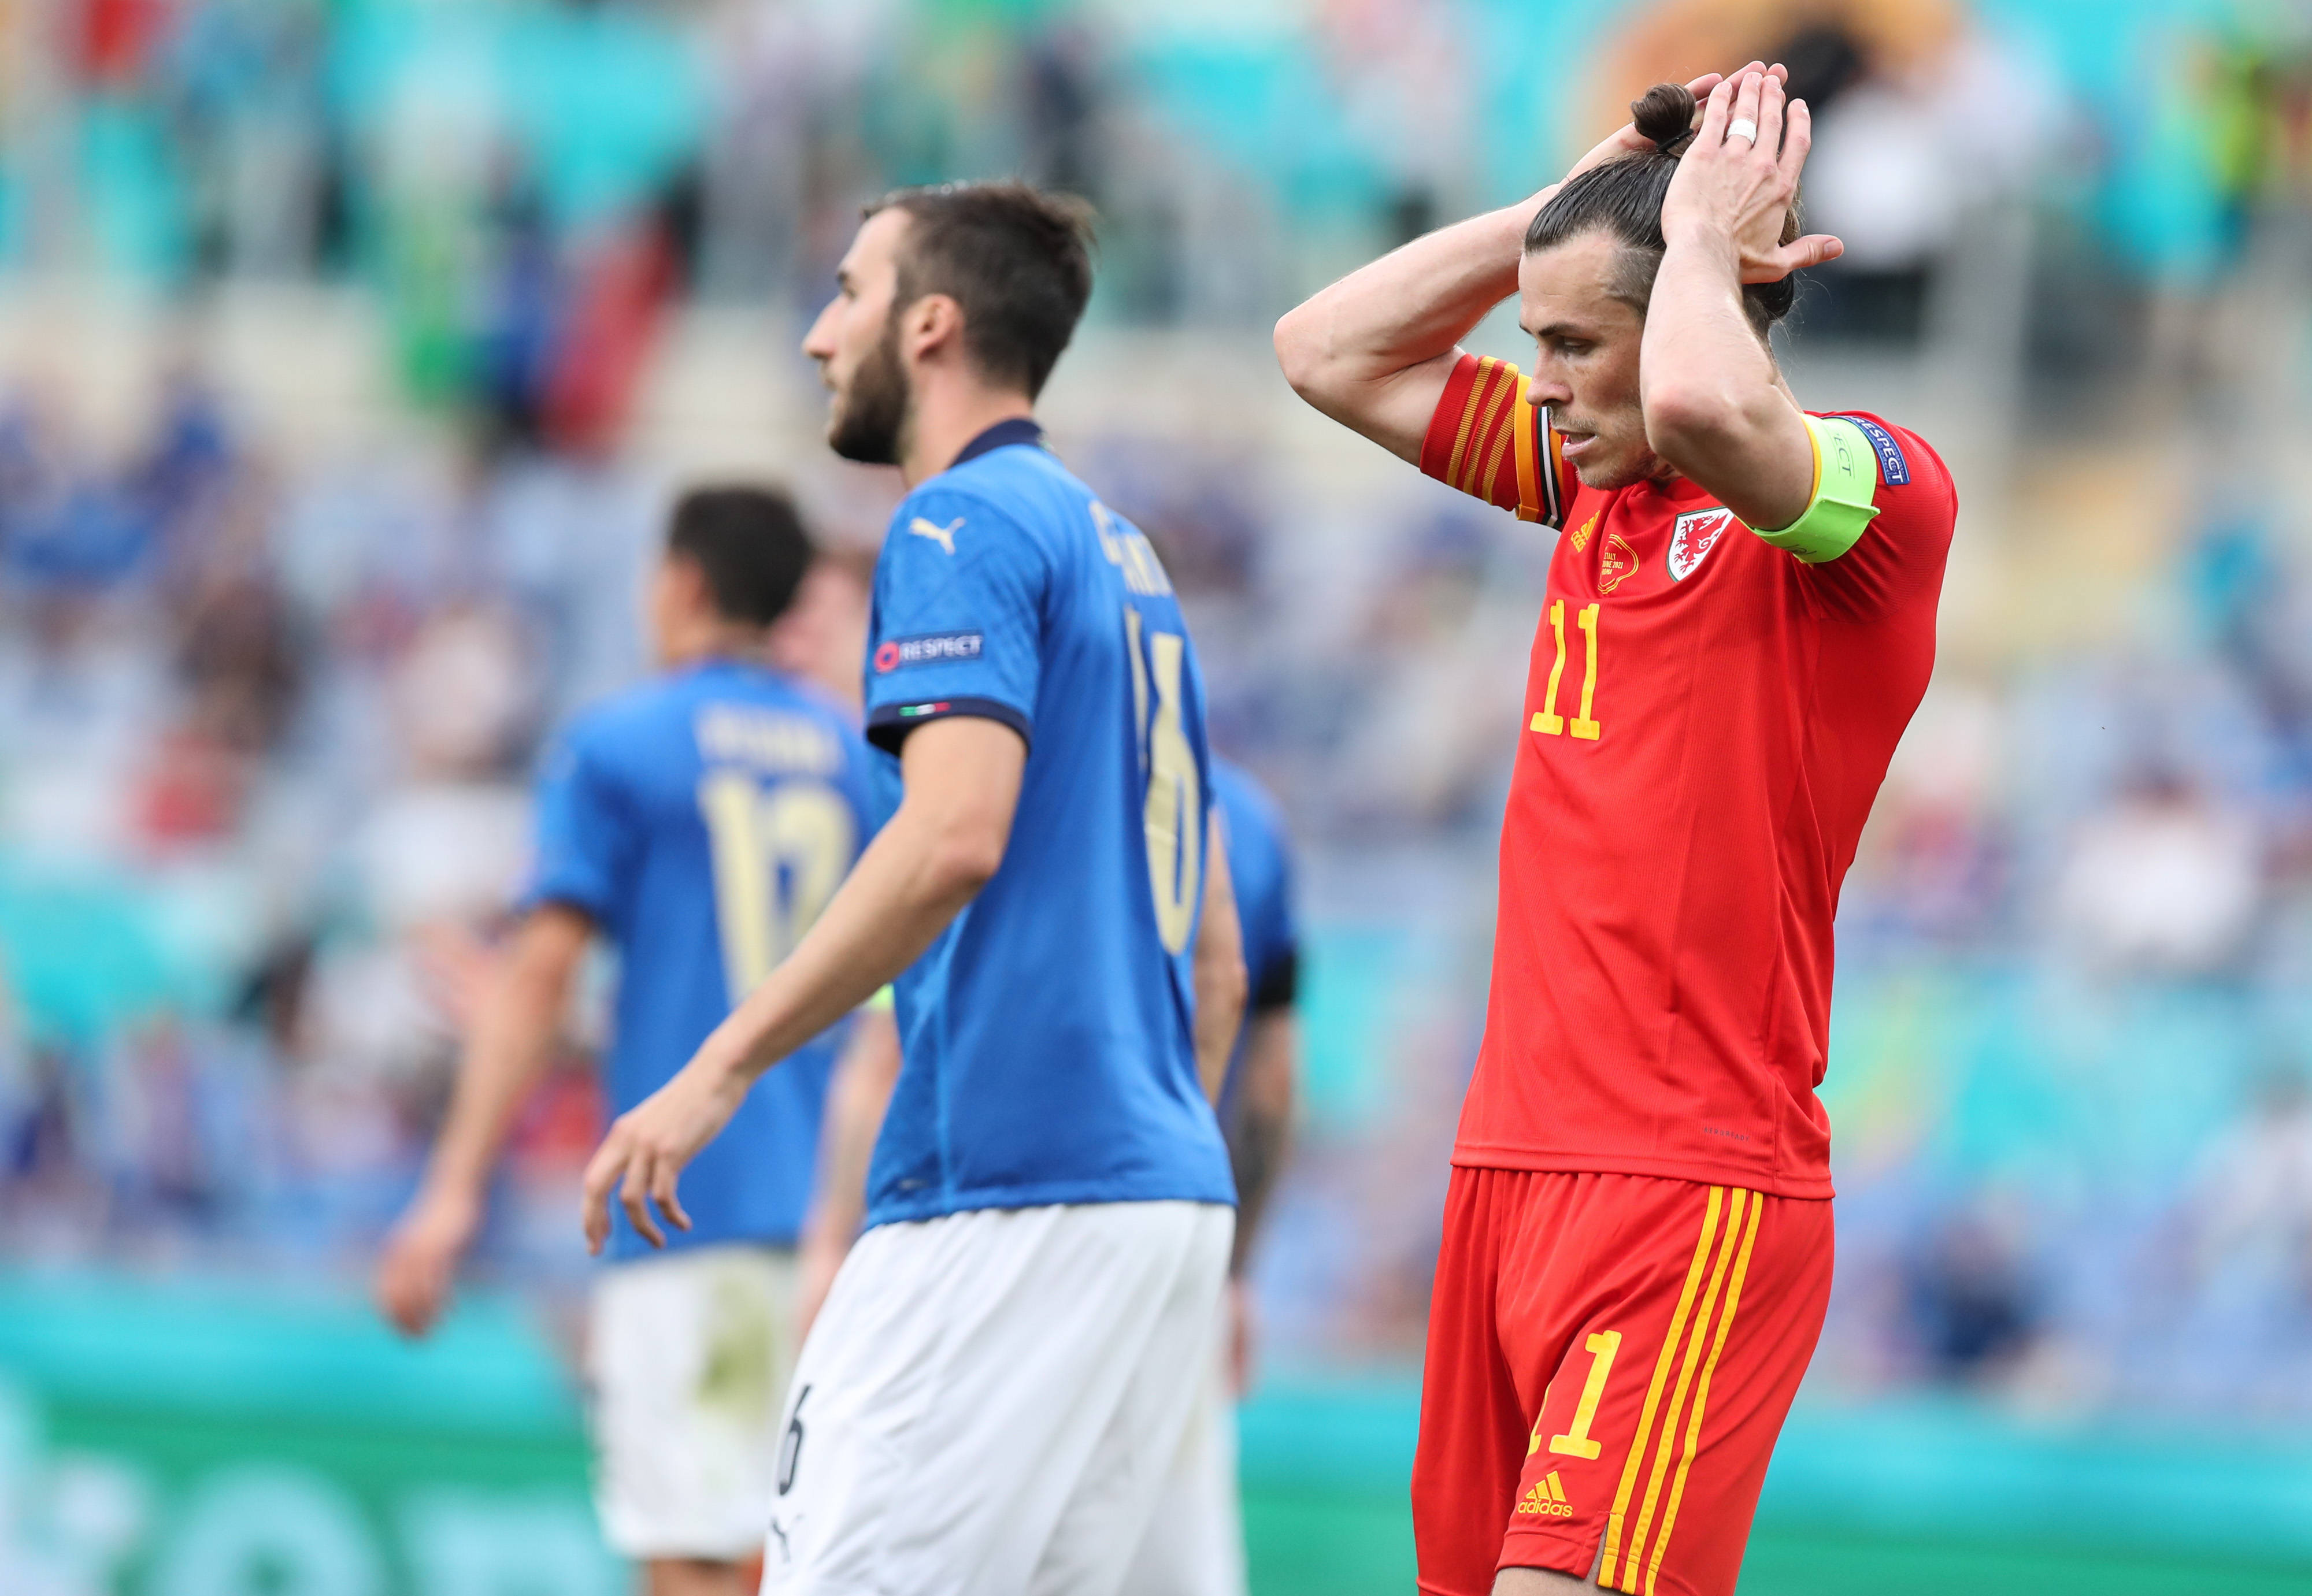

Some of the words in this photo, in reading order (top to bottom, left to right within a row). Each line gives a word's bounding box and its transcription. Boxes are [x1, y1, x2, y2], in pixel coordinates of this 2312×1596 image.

[1851, 417, 1903, 482] RESPECT
[899, 635, 983, 660] RESPECT
[1531, 599, 1600, 741] 11
[1125, 603, 1201, 955] 16
[1527, 1330, 1622, 1460] 1
[1518, 1498, 1573, 1517] adidas
